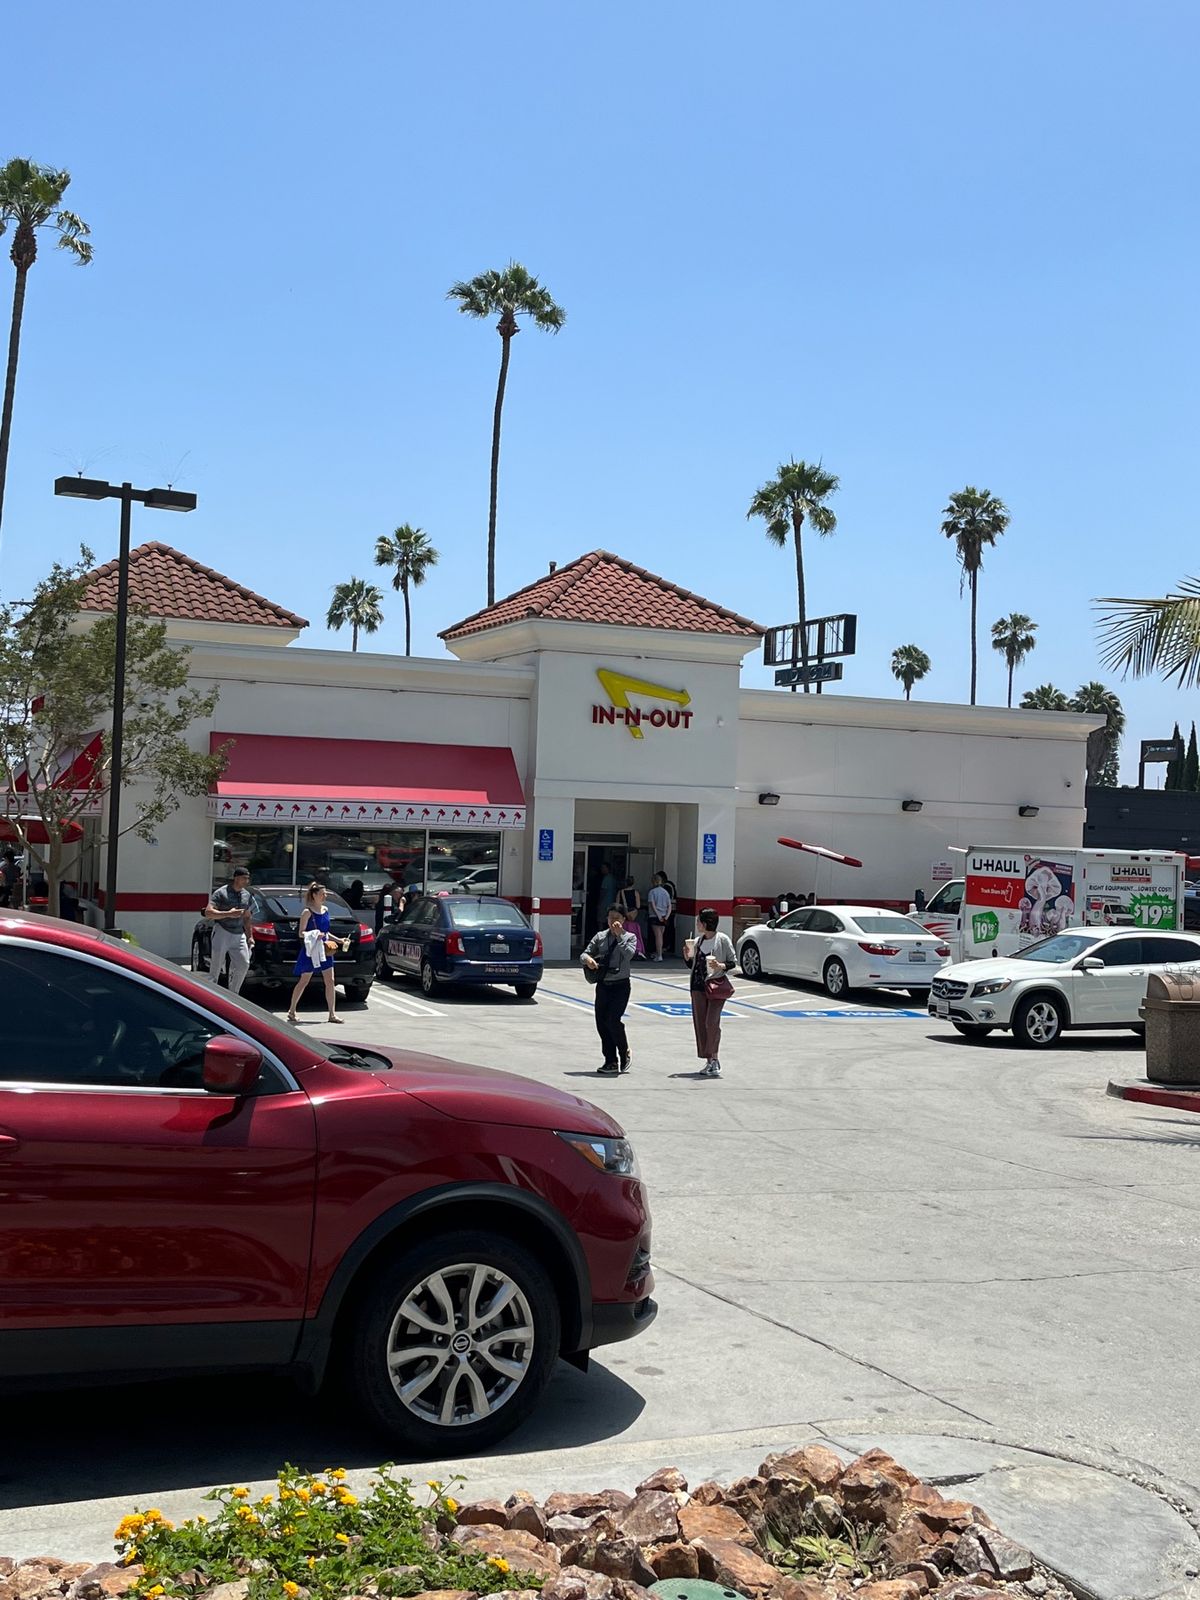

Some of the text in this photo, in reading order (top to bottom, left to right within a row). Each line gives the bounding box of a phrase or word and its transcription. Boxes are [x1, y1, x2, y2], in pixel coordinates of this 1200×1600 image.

[592, 705, 693, 729] IN-N-OUT
[972, 858, 1020, 873] U-HAUL
[1112, 867, 1150, 876] U-HAUL
